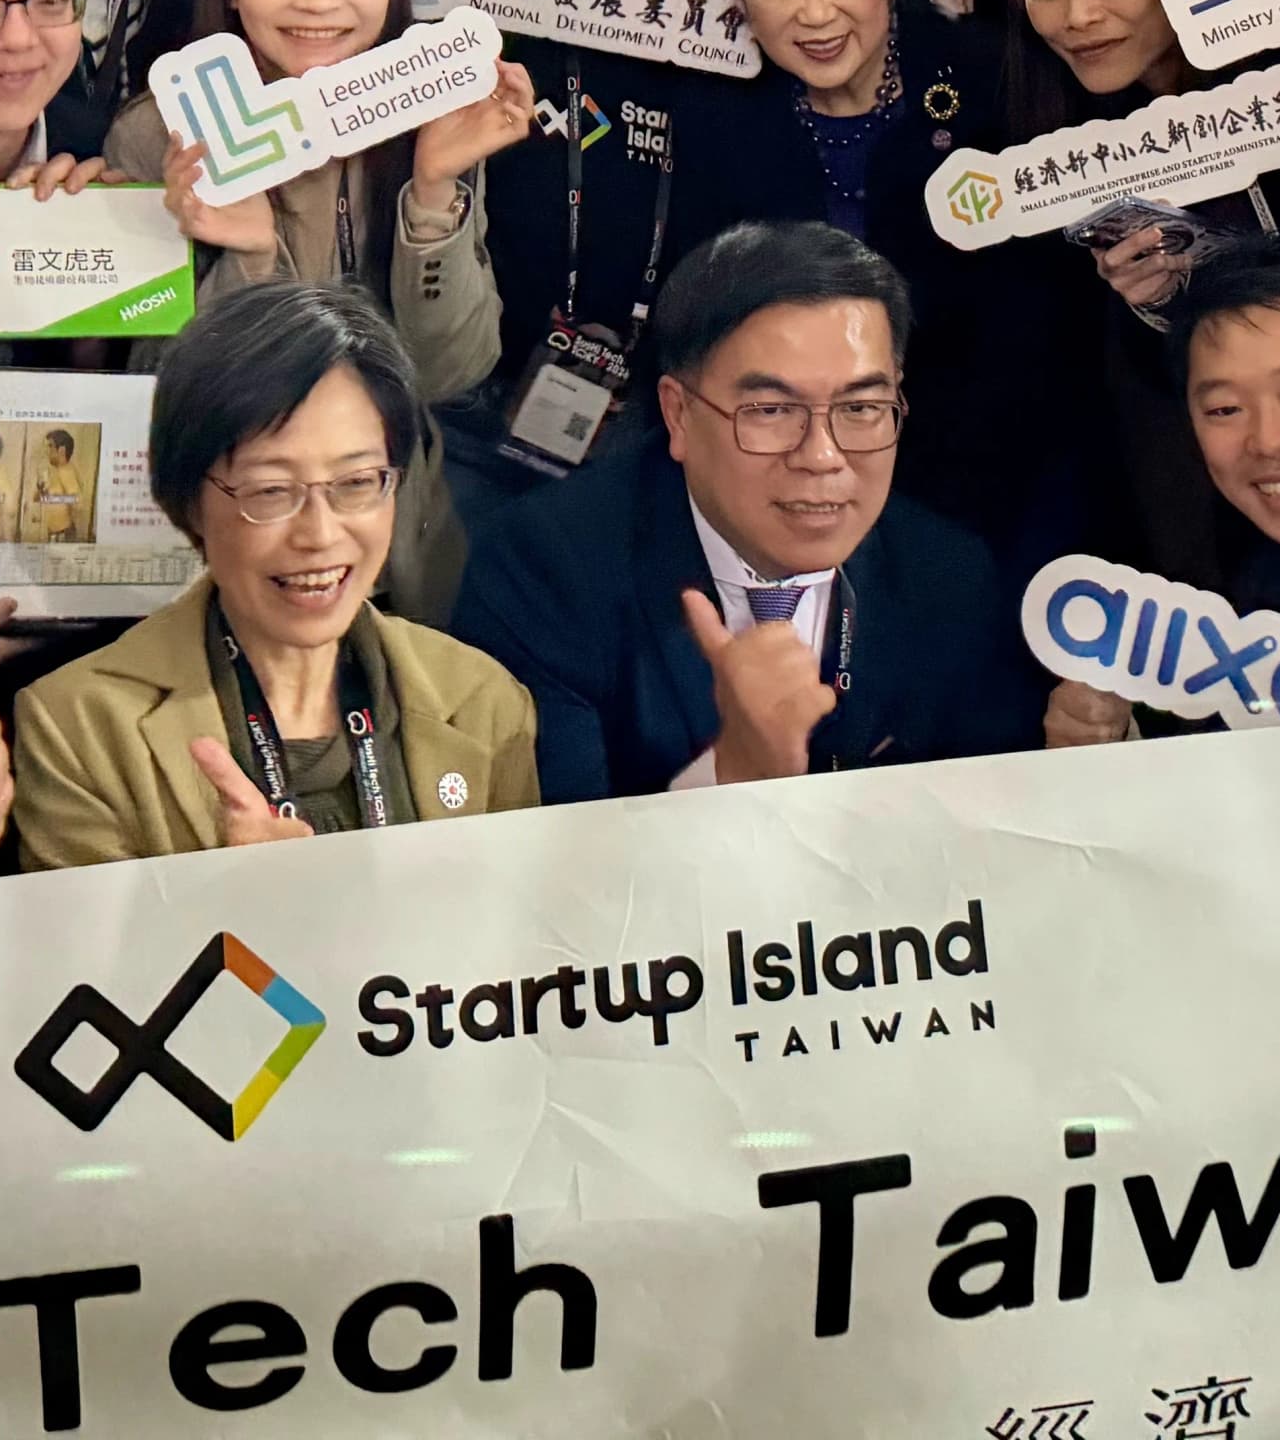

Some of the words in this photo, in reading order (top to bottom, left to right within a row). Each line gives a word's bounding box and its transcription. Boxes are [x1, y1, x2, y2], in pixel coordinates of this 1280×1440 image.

[555, 13, 665, 51] DEVELOPMENT
[1201, 8, 1275, 48] Ministry
[318, 26, 483, 110] Leeuwenhoek
[330, 61, 478, 138] Laboratories
[626, 124, 665, 153] Isla
[1020, 201, 1050, 214] SMALL
[1049, 193, 1069, 207] AND
[1069, 183, 1106, 201] MEDIUM
[1106, 168, 1162, 192] ENTERPRISE
[1162, 160, 1182, 175] AND
[1182, 151, 1222, 169] STARTUP
[1147, 170, 1198, 191] ECONOMIC
[1199, 159, 1236, 178] AFFAIRS
[12, 247, 116, 272] 雷文虎克
[119, 286, 177, 322] HAOSHI
[356, 953, 704, 1059] Startup
[726, 899, 988, 1006] Island
[735, 999, 999, 1064] TAIWAN
